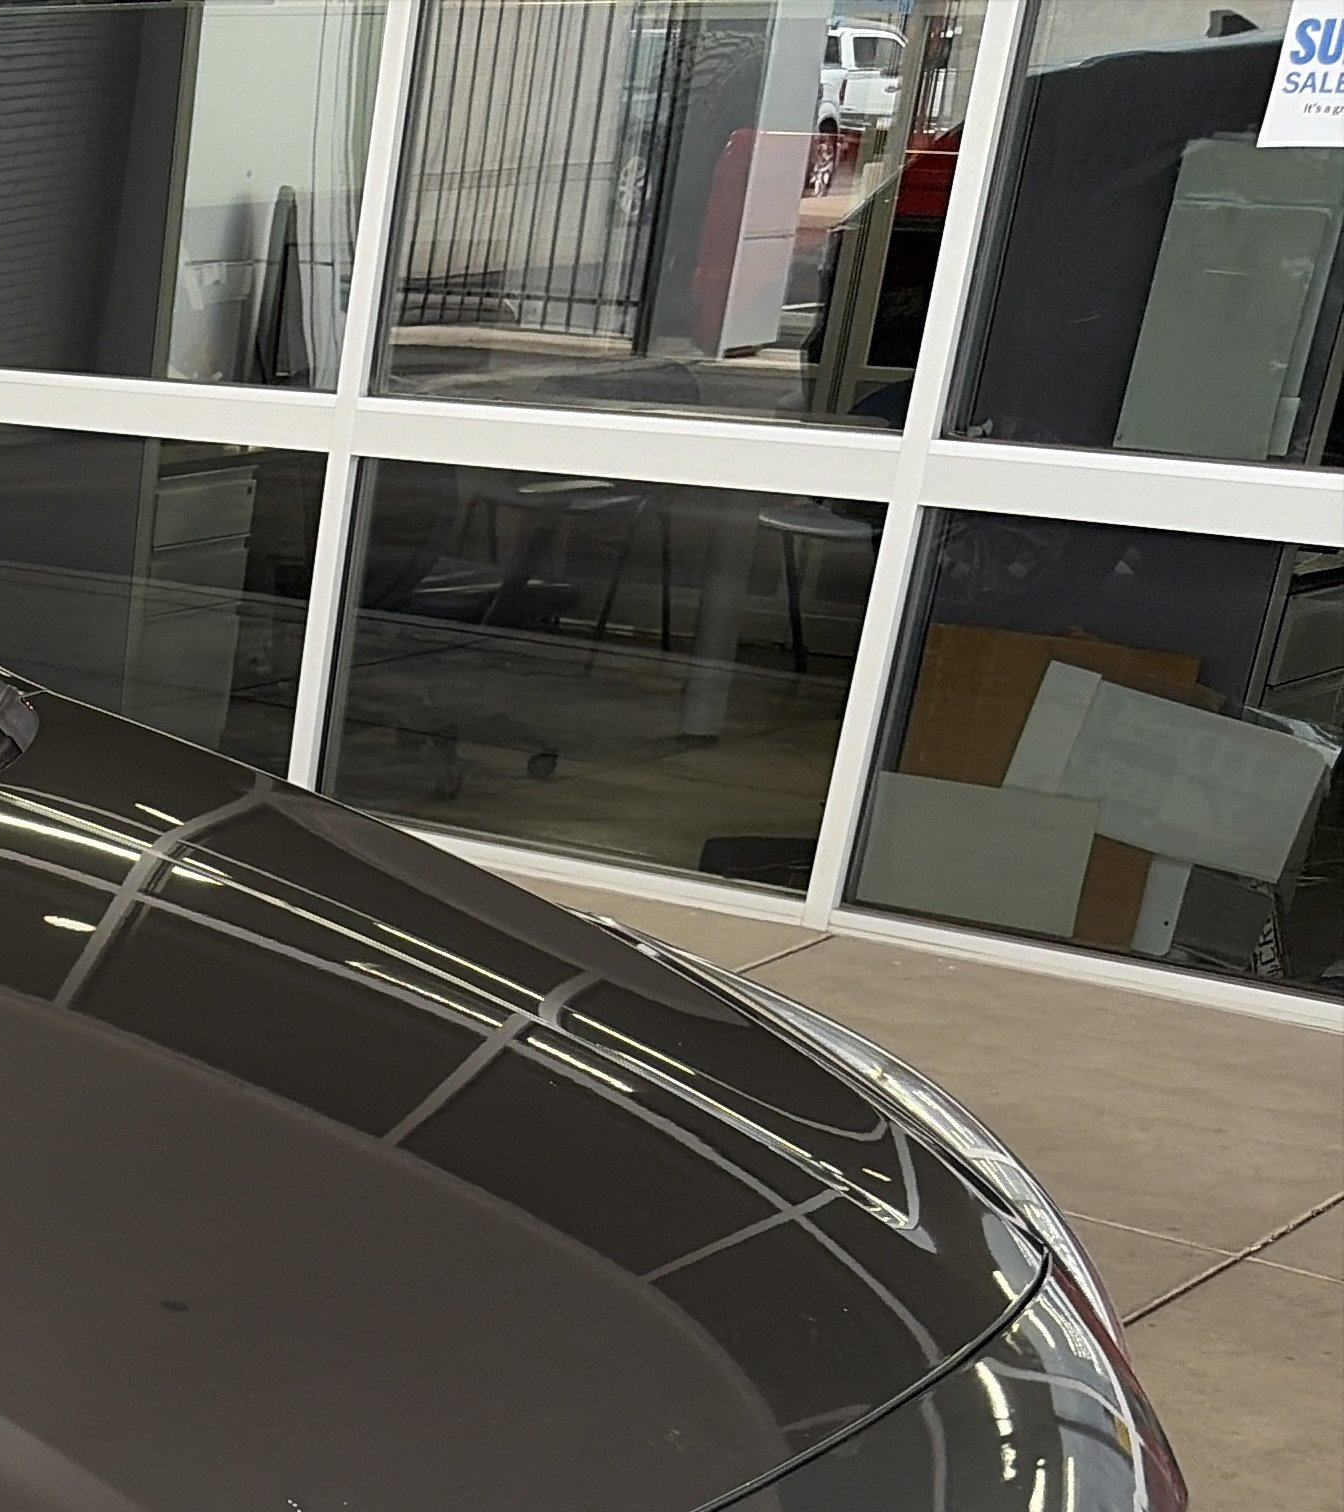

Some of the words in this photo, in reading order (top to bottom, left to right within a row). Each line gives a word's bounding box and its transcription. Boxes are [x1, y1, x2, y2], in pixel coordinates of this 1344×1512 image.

[1290, 18, 1344, 66] SU
[1304, 103, 1322, 114] It's
[1323, 106, 1331, 114] a
